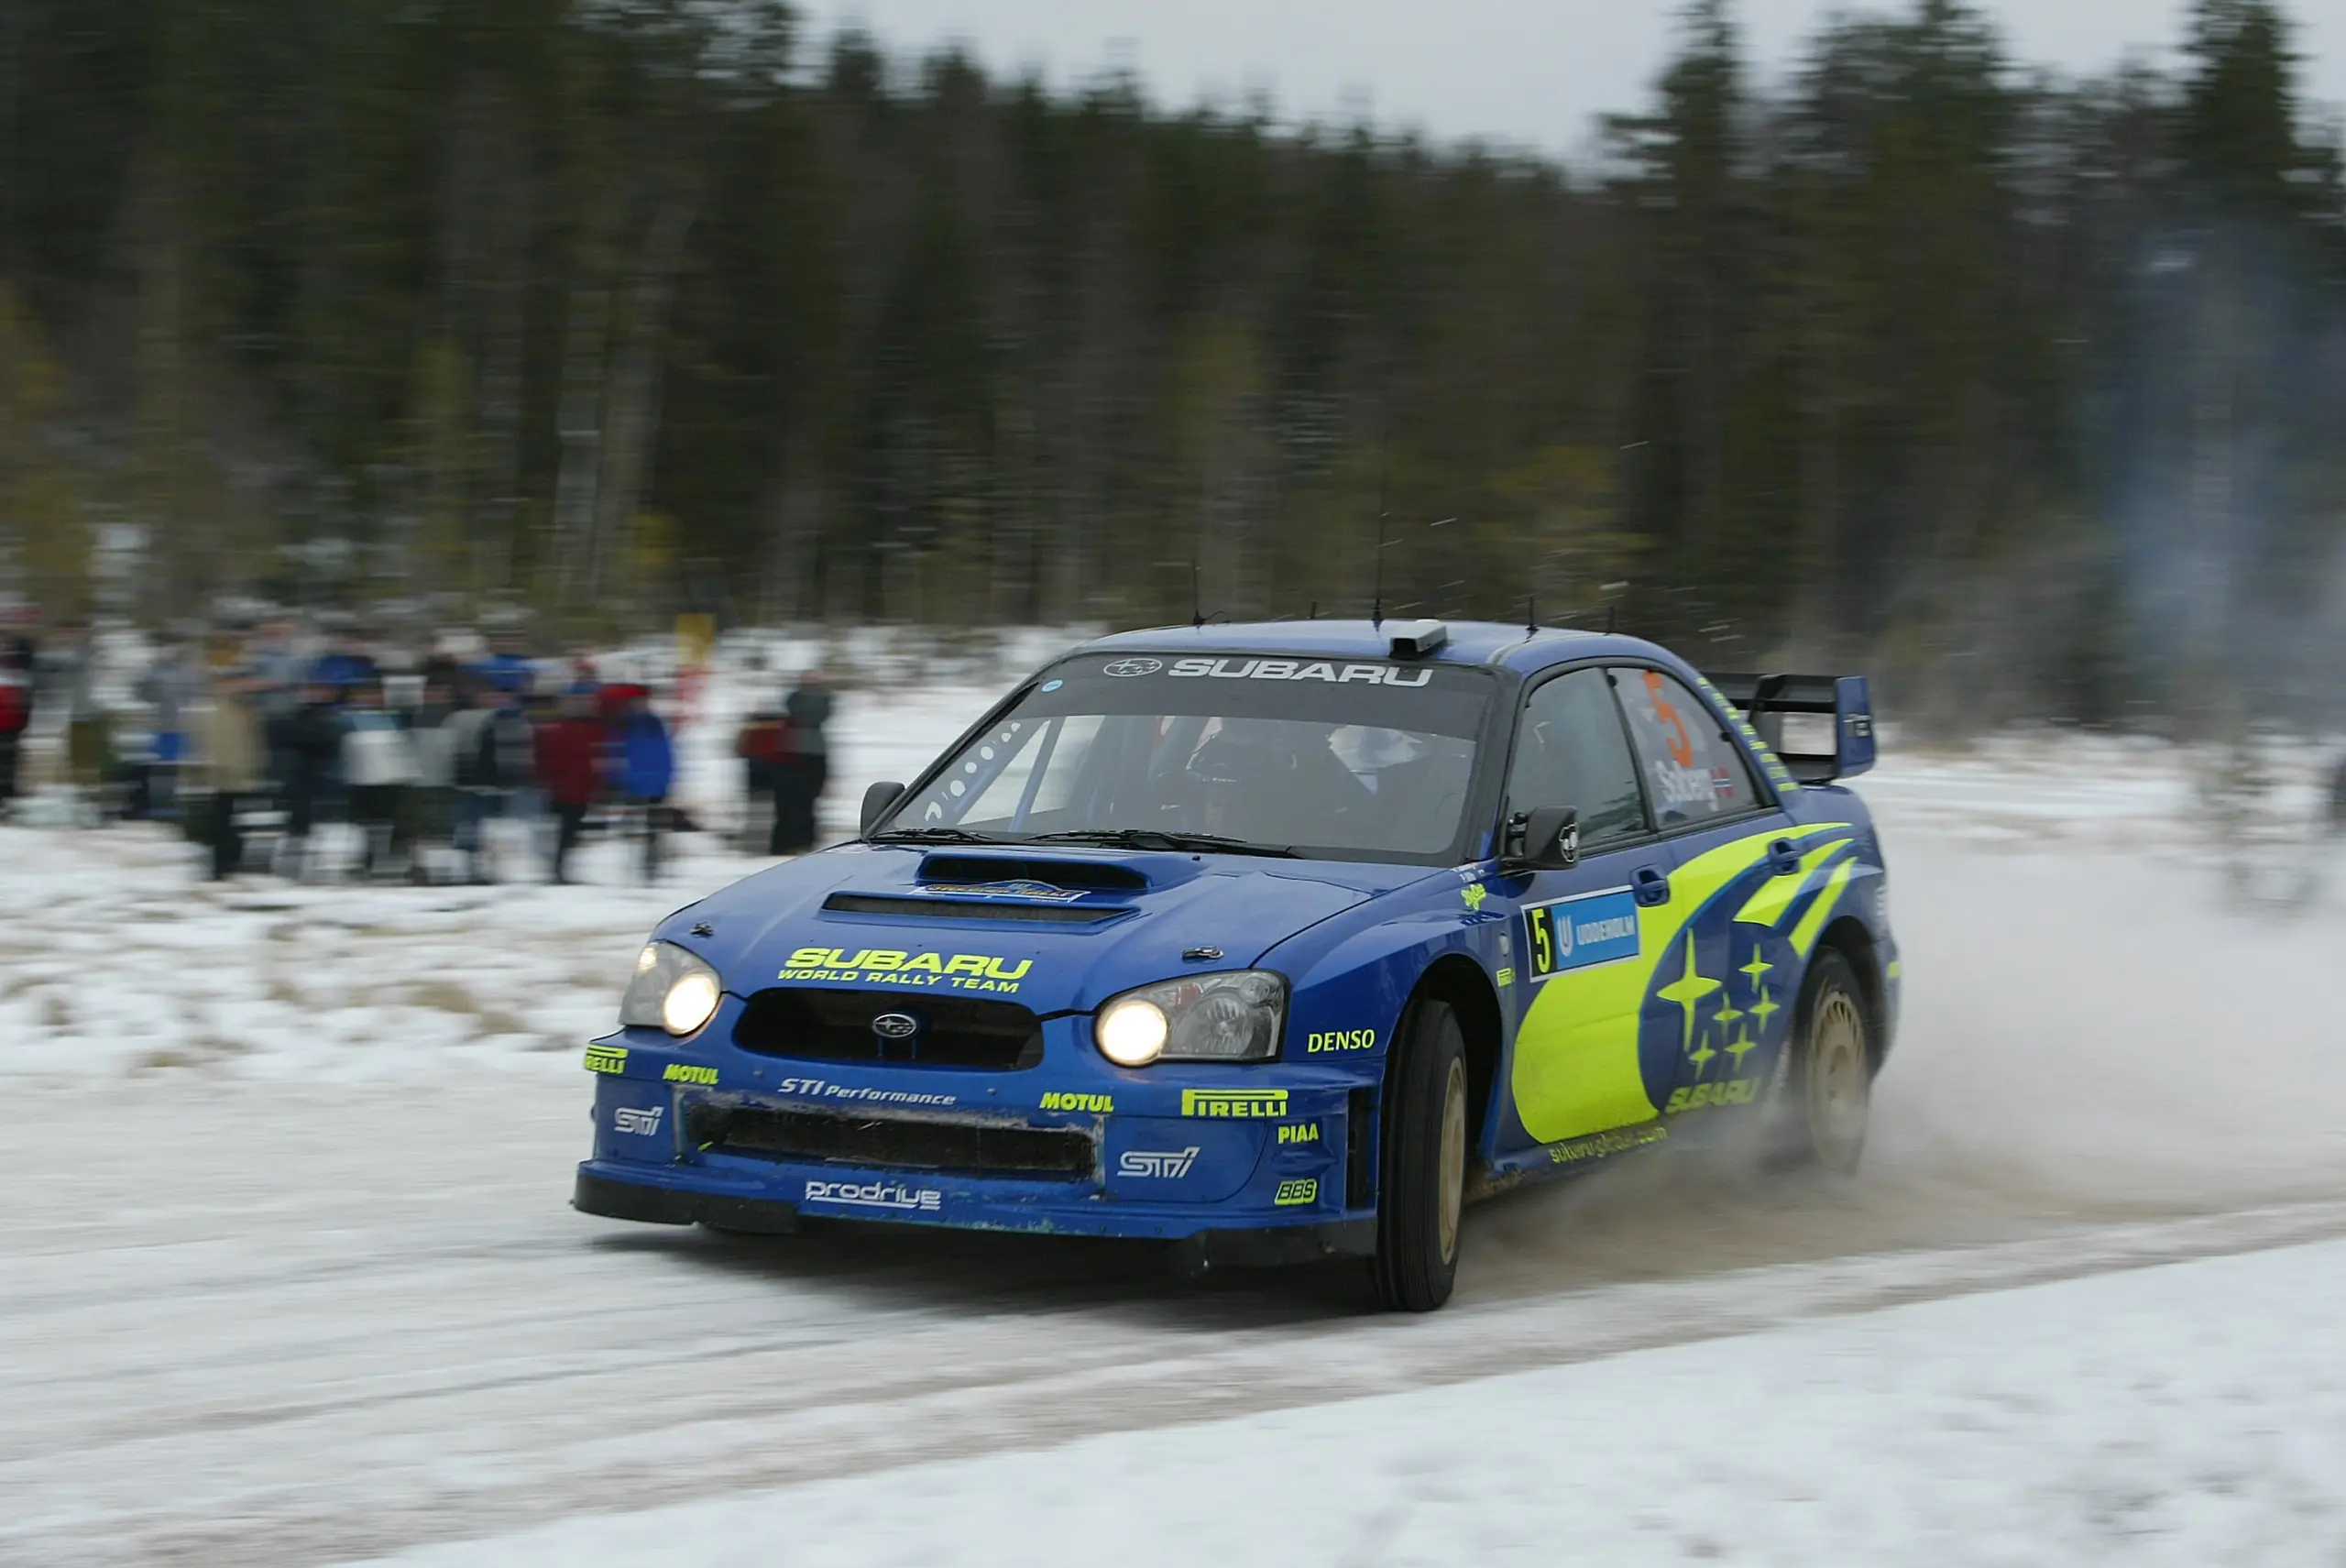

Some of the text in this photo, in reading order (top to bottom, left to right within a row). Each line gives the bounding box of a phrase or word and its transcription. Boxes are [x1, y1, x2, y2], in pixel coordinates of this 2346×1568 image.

[1168, 658, 1432, 687] SUBARU
[1642, 670, 1693, 769] 5
[1531, 907, 1551, 973] 5
[785, 948, 1033, 980] SUBARU
[778, 970, 1019, 993] WORLD RALLY TEAM
[1308, 1028, 1376, 1054] DENSO
[663, 1063, 719, 1085] MOTUL
[778, 1078, 957, 1105] STI Performance
[1039, 1091, 1114, 1113] MOTUL
[1181, 1089, 1288, 1117] PIRELLI
[1277, 1123, 1319, 1145] PIAA
[1277, 1180, 1316, 1204] BBS
